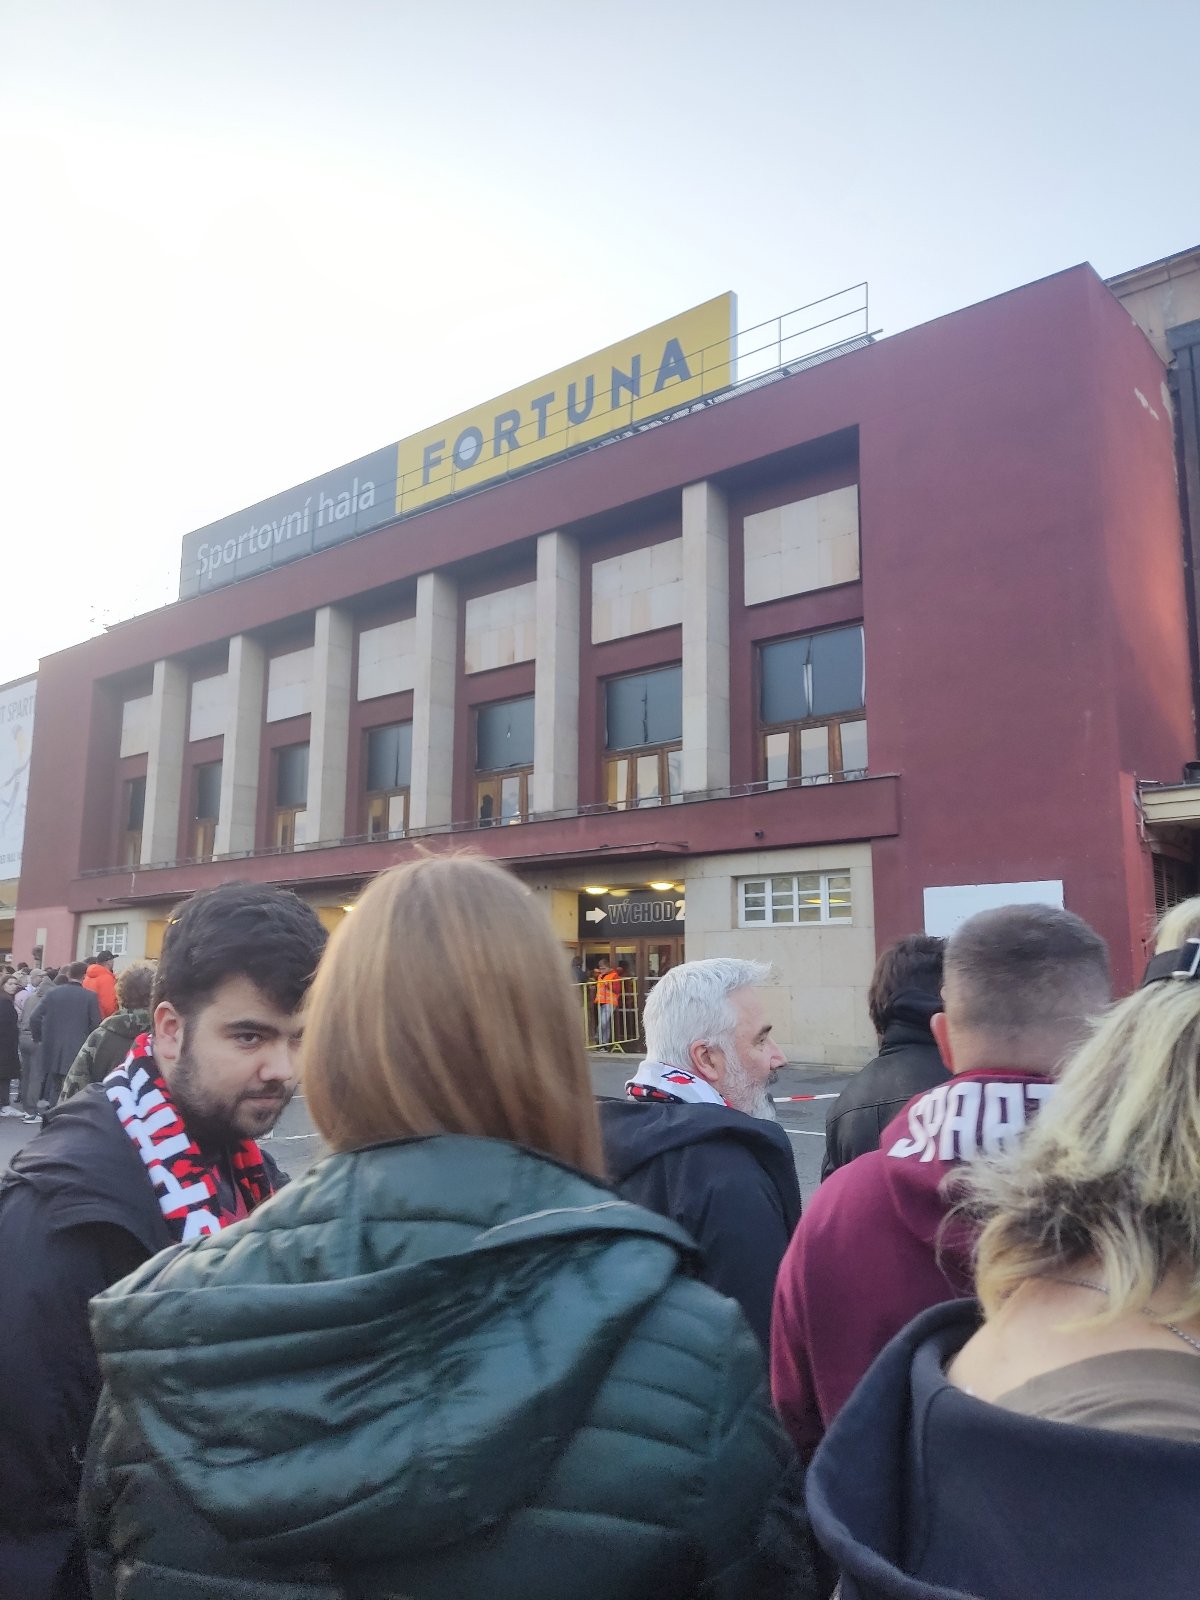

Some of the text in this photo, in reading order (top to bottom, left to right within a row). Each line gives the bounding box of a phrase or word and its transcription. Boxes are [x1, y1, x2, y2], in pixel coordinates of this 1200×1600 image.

[422, 337, 692, 486] FORTUNA
[195, 477, 376, 580] Sportovní hala
[608, 898, 675, 925] VÝCHOD
